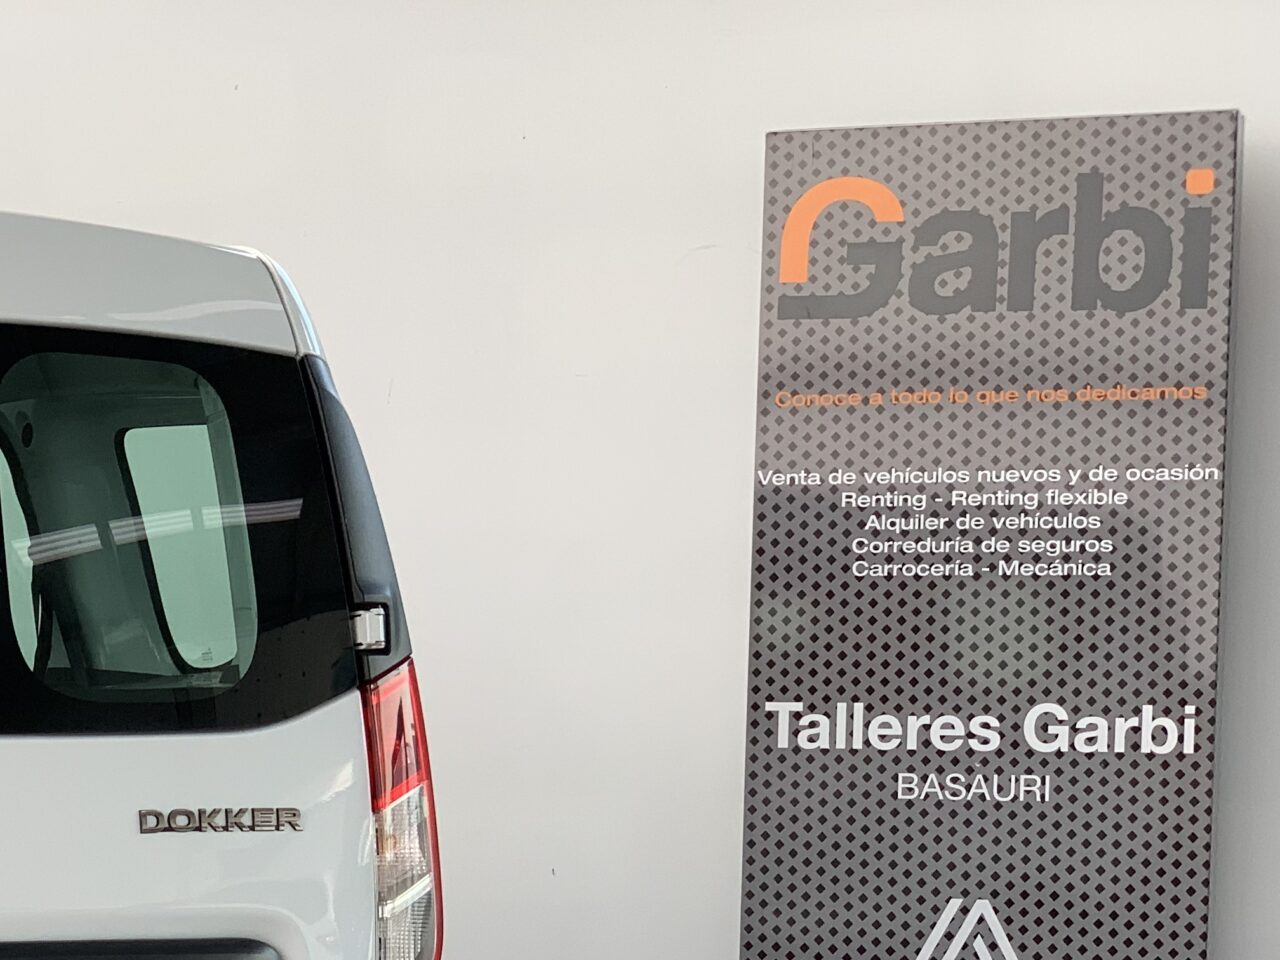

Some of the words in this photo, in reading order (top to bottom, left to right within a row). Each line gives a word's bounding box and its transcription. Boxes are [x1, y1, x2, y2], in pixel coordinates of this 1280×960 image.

[777, 168, 1215, 320] Garbi
[775, 390, 862, 408] Conoce
[869, 392, 884, 406] a
[891, 388, 942, 405] todo
[949, 387, 969, 404] lo
[976, 388, 1019, 405] que
[1026, 387, 1069, 403] nos
[1076, 384, 1208, 402] dedicamos
[757, 470, 822, 486] Venta
[828, 469, 857, 485] de
[864, 467, 970, 484] vehículos
[977, 468, 1062, 483] nuevos
[1068, 467, 1082, 486] y
[1088, 465, 1119, 482] de
[1125, 464, 1219, 482] ocasión
[840, 490, 927, 511] Renting
[950, 489, 1039, 510] Renting
[1046, 488, 1129, 506] flexible
[864, 514, 949, 534] Alquiler
[955, 513, 985, 530] de
[992, 512, 1102, 530] vehículos
[851, 537, 974, 554] Correduría
[981, 537, 1011, 554] de
[1017, 538, 1114, 557] seguros
[851, 560, 974, 577] Carrocería
[998, 559, 1112, 577] Mecánica
[765, 700, 1002, 753] Talleres
[1023, 702, 1198, 755] Garbi
[897, 772, 1051, 803] BASAURI
[138, 807, 304, 835] DOKKER
